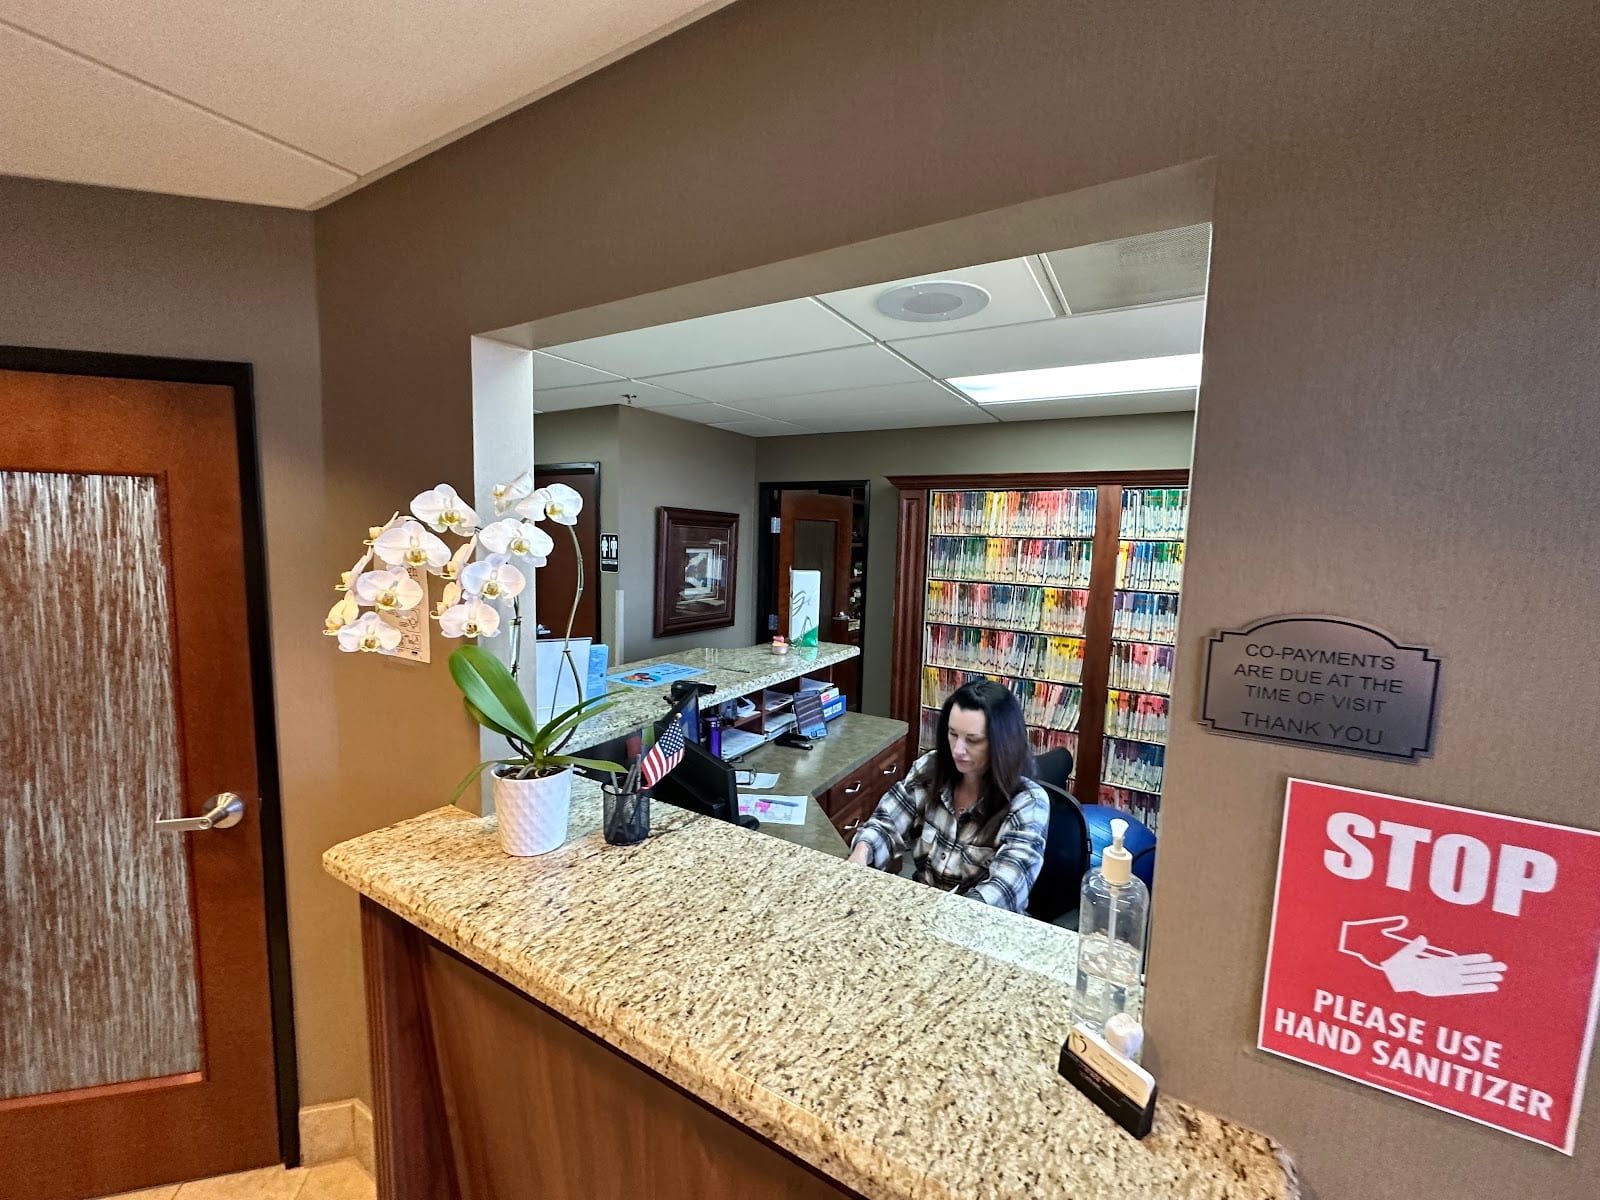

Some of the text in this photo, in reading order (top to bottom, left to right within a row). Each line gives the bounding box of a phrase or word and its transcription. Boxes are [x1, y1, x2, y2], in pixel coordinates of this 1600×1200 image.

[1245, 643, 1397, 670] CO-PAYMENTS
[1234, 664, 1403, 694] ARE DUE AT THE
[1245, 684, 1387, 715] TIME OF VISIT
[1241, 711, 1384, 745] THANK YOU
[1323, 811, 1558, 917] STOP
[1313, 988, 1503, 1069] PLEASE USE
[1274, 1007, 1554, 1122] HAND SANITIZER
